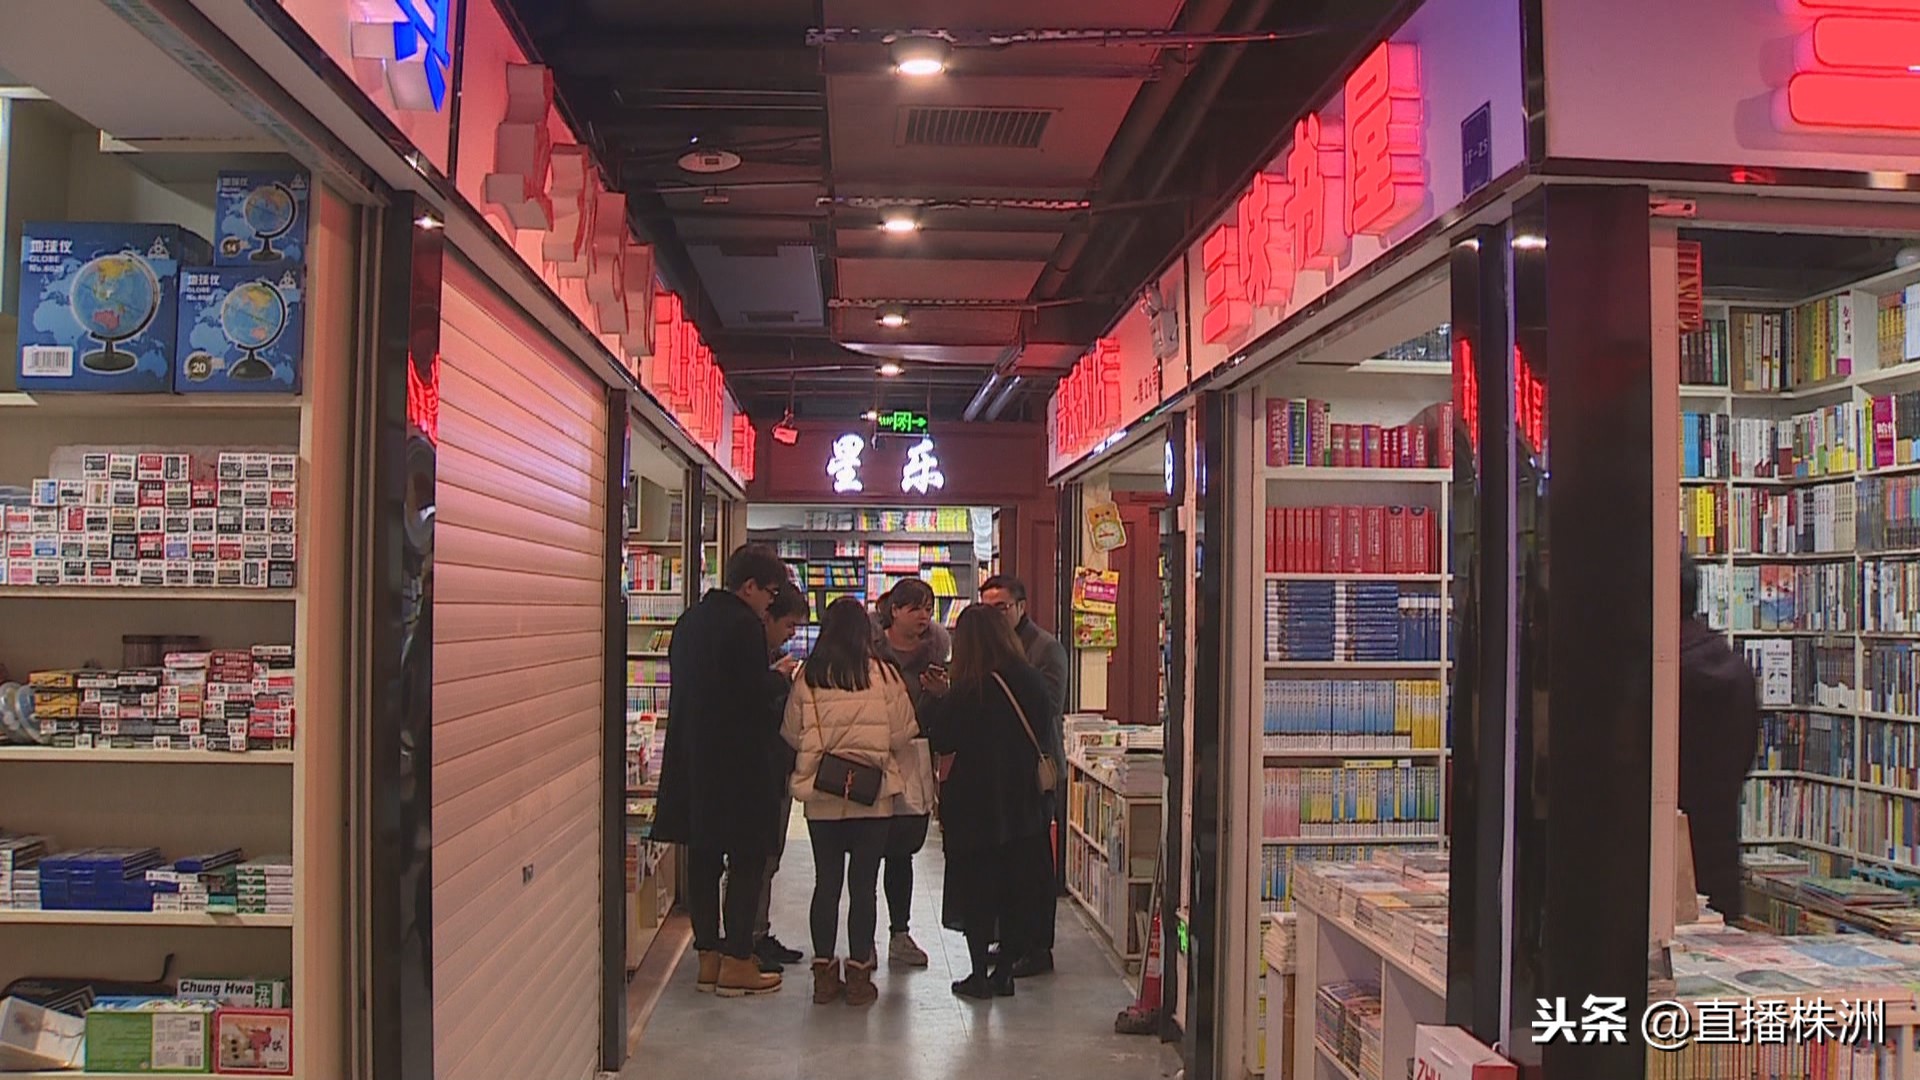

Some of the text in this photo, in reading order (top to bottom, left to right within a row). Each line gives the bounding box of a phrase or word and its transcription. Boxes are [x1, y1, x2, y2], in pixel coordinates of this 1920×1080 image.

[1202, 41, 1402, 345] 三味书屋
[31, 239, 73, 255] 地球仪
[29, 255, 60, 263] GLOBE
[187, 273, 220, 286] 地球仪
[192, 362, 206, 374] 20
[180, 981, 254, 996] Chung Hwa
